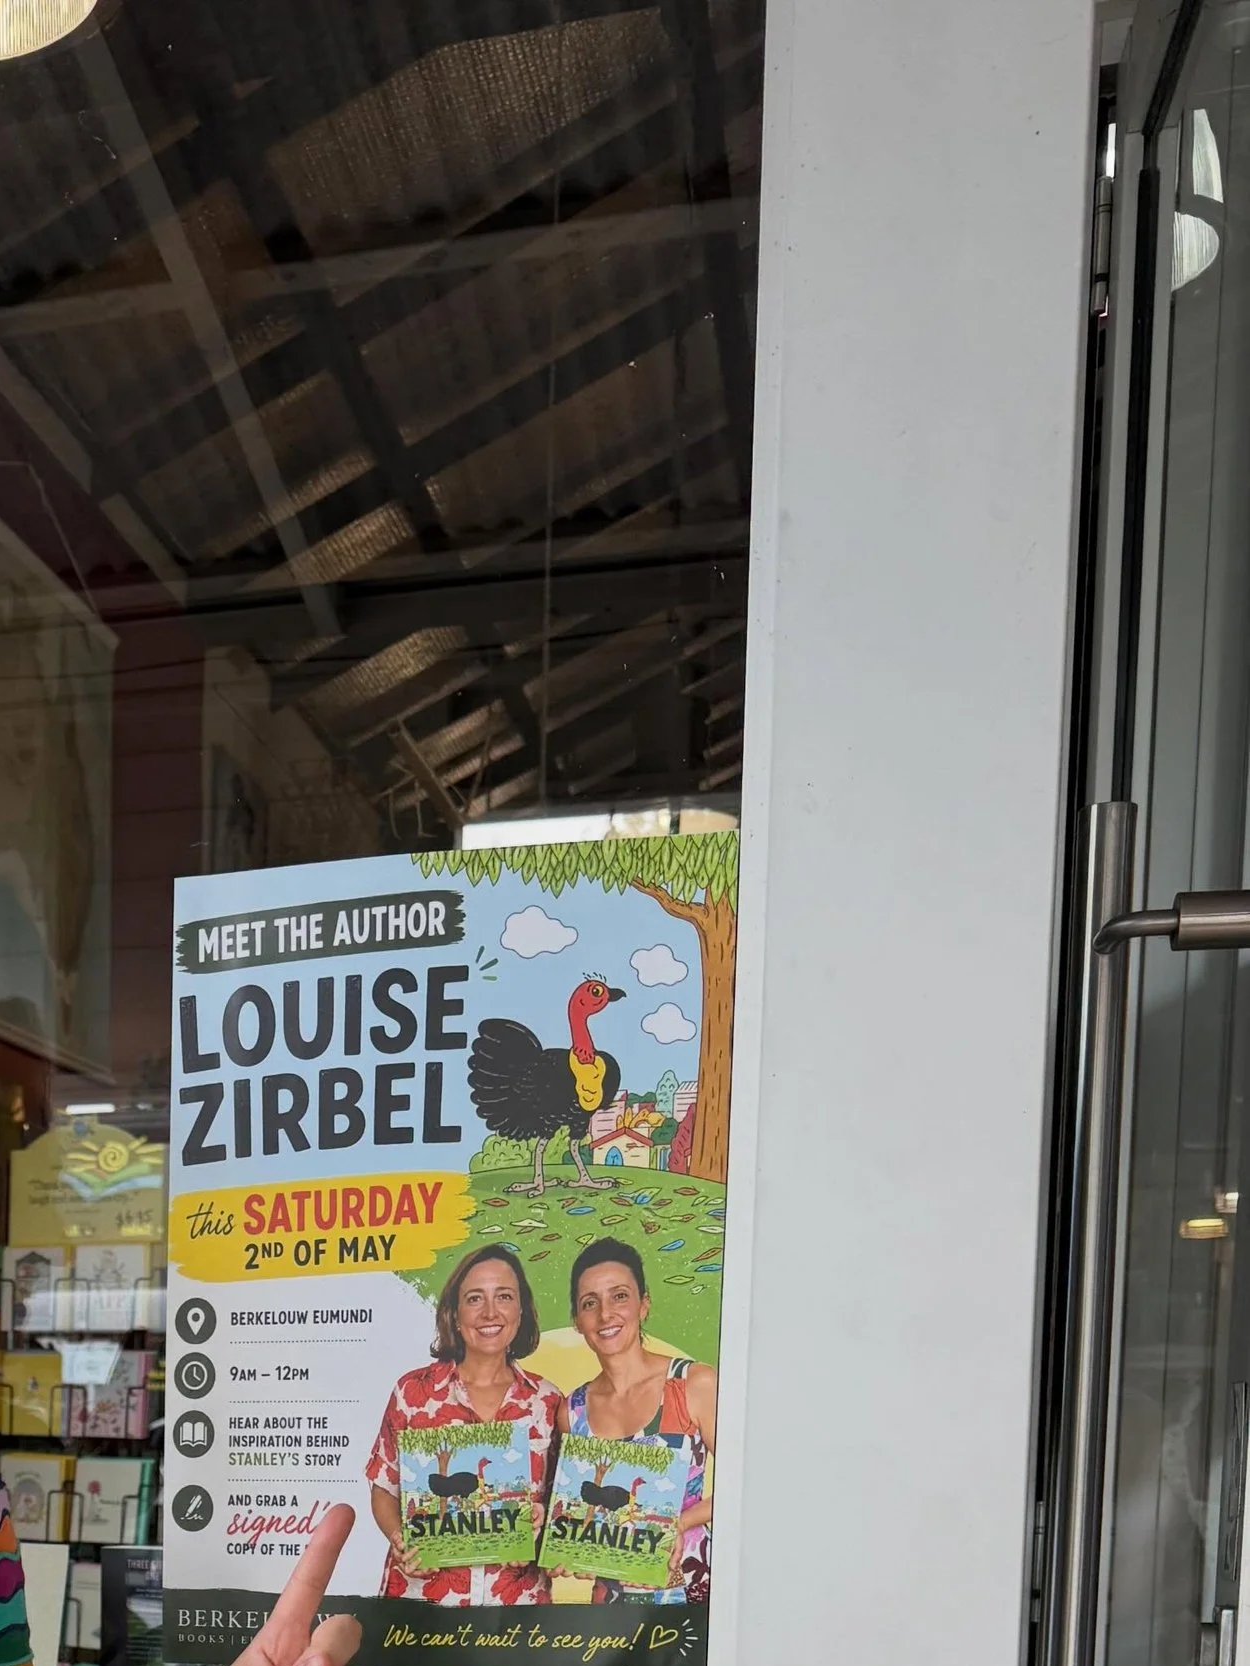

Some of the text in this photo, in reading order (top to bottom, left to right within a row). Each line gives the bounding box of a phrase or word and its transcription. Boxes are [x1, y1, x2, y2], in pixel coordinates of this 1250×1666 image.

[198, 900, 447, 963] MEET THE AUTHOR
[179, 964, 470, 1074] LOUISE
[179, 1061, 462, 1167] ZIRBEL
[187, 1181, 443, 1240] this SATURDAY
[244, 1234, 397, 1271] 2ND OF MAY
[230, 1308, 373, 1326] BERKELOUW EUMUNDI
[230, 1366, 257, 1381] 9AM
[275, 1365, 309, 1381] 12PM
[229, 1417, 328, 1430] HEAR ABOUT THE
[228, 1435, 350, 1448] INSPIRATION BEHIND
[228, 1452, 342, 1467] STANLEY'S STORY
[227, 1494, 299, 1507] AND GRAB A
[226, 1500, 320, 1550] signed
[410, 1508, 521, 1539] STANLEY
[551, 1515, 665, 1555] STANLEY
[226, 1543, 256, 1555] COPY
[260, 1543, 275, 1555] OF
[279, 1543, 301, 1556] THE
[178, 1634, 225, 1644] BOOKS
[384, 1623, 644, 1662] We can't wait to see you!
